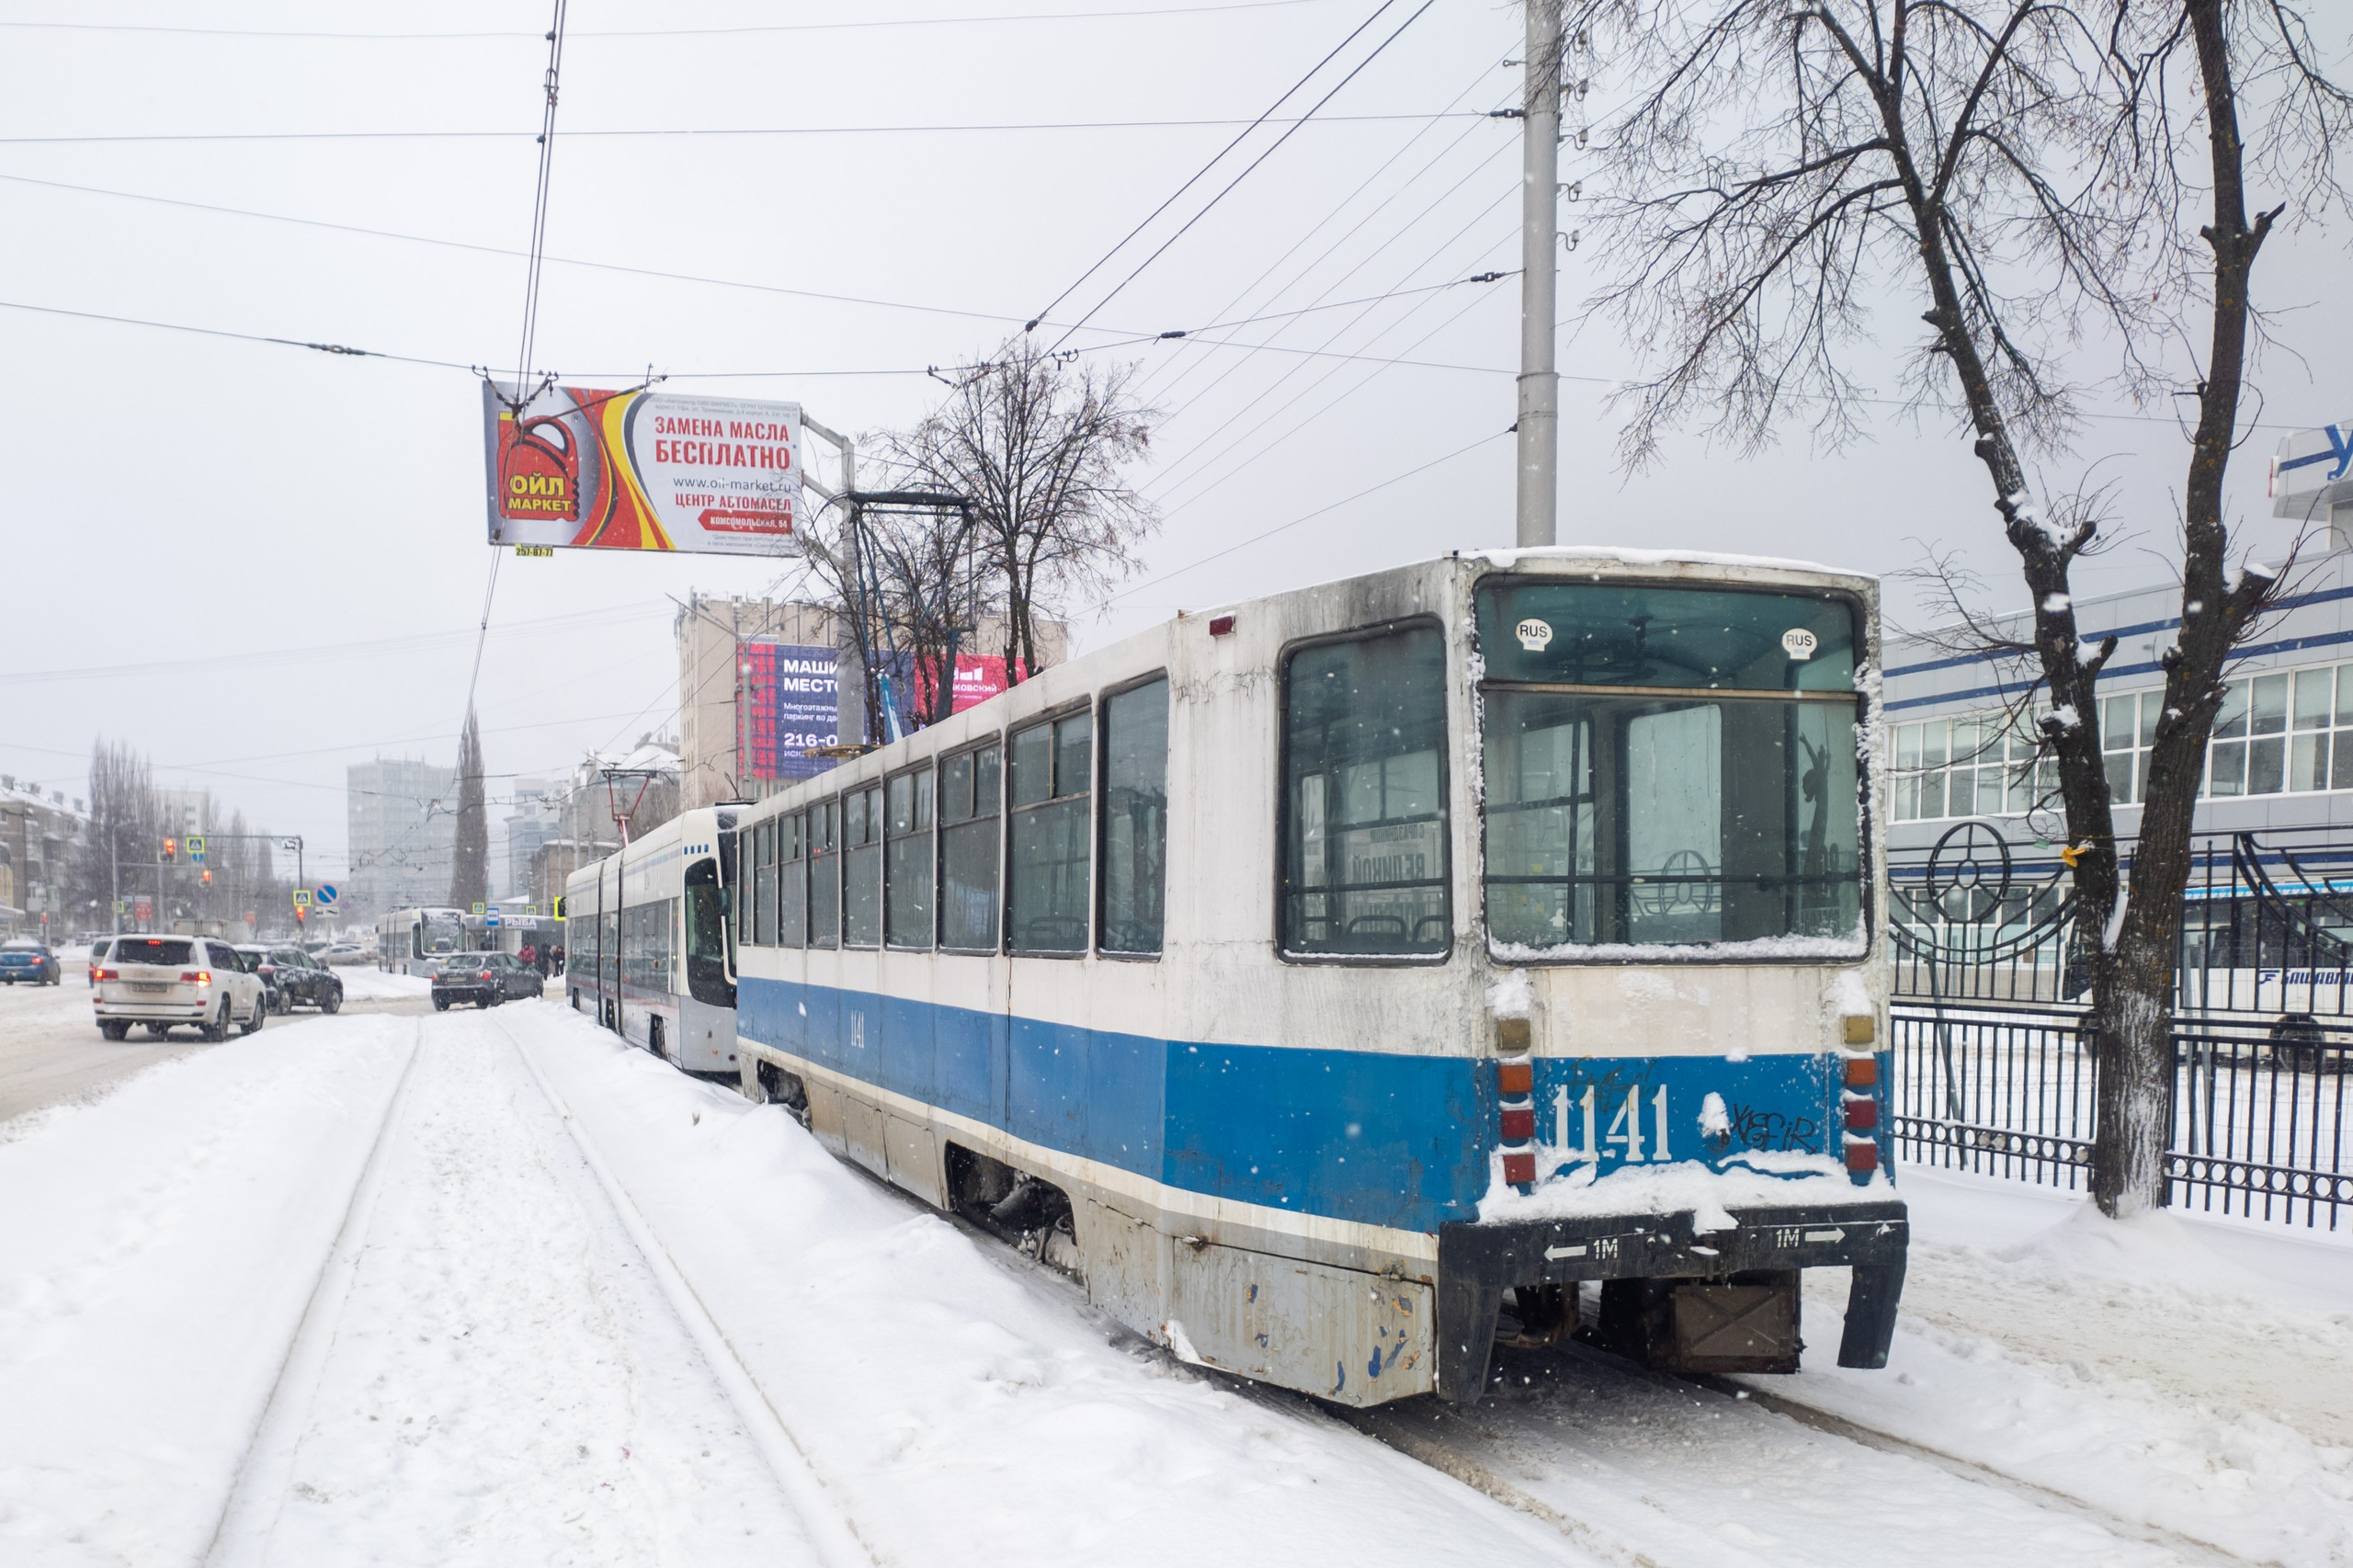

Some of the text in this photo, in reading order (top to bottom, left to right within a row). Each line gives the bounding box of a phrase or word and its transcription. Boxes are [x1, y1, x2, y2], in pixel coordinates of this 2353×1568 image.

[654, 415, 790, 441] ЗАМЕНА МАСЛА
[509, 472, 564, 496] ОЙЛ
[673, 477, 791, 493] www.oil-market.ru
[508, 497, 572, 512] МАРКЕТ
[676, 493, 791, 511] ЦЕНТР АВТОМАСЕЛ
[1519, 624, 1548, 638] RUS
[1786, 634, 1813, 646] RUS
[784, 677, 837, 692] МЕСТ
[784, 713, 814, 722] паркинг
[505, 917, 537, 927] РЫБА
[850, 1009, 865, 1049] 1141
[1553, 1084, 1672, 1162] 1141
